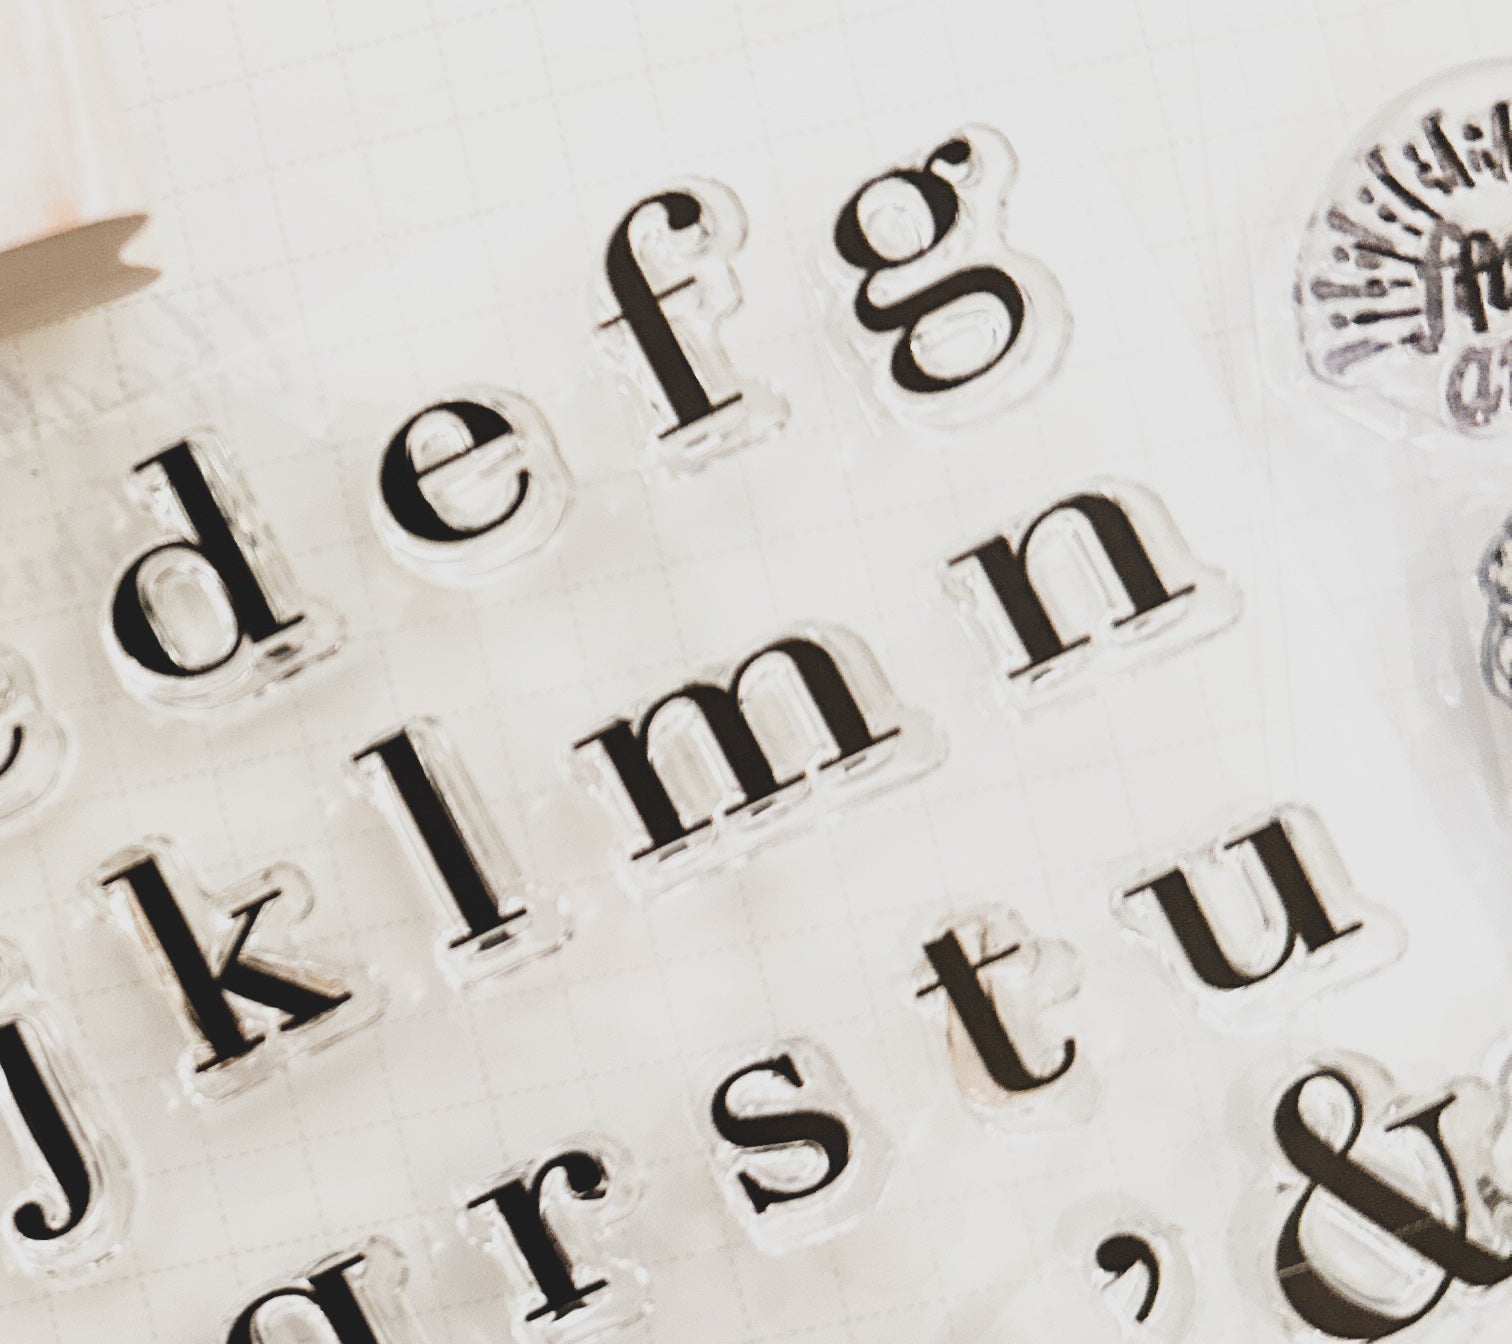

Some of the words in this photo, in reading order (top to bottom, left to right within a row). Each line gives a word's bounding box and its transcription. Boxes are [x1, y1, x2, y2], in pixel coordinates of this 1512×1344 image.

[110, 439, 308, 680] d
[379, 397, 531, 544] e
[600, 190, 746, 438] f
[833, 139, 1025, 394] g
[101, 856, 353, 1074] k
[351, 730, 528, 950] l
[573, 638, 901, 862] m
[949, 494, 1196, 680] n
[466, 1151, 609, 1323] r
[710, 1053, 850, 1215] s
[915, 929, 1076, 1093] t
[1123, 820, 1363, 990] u
[1273, 1066, 1512, 1344] &
